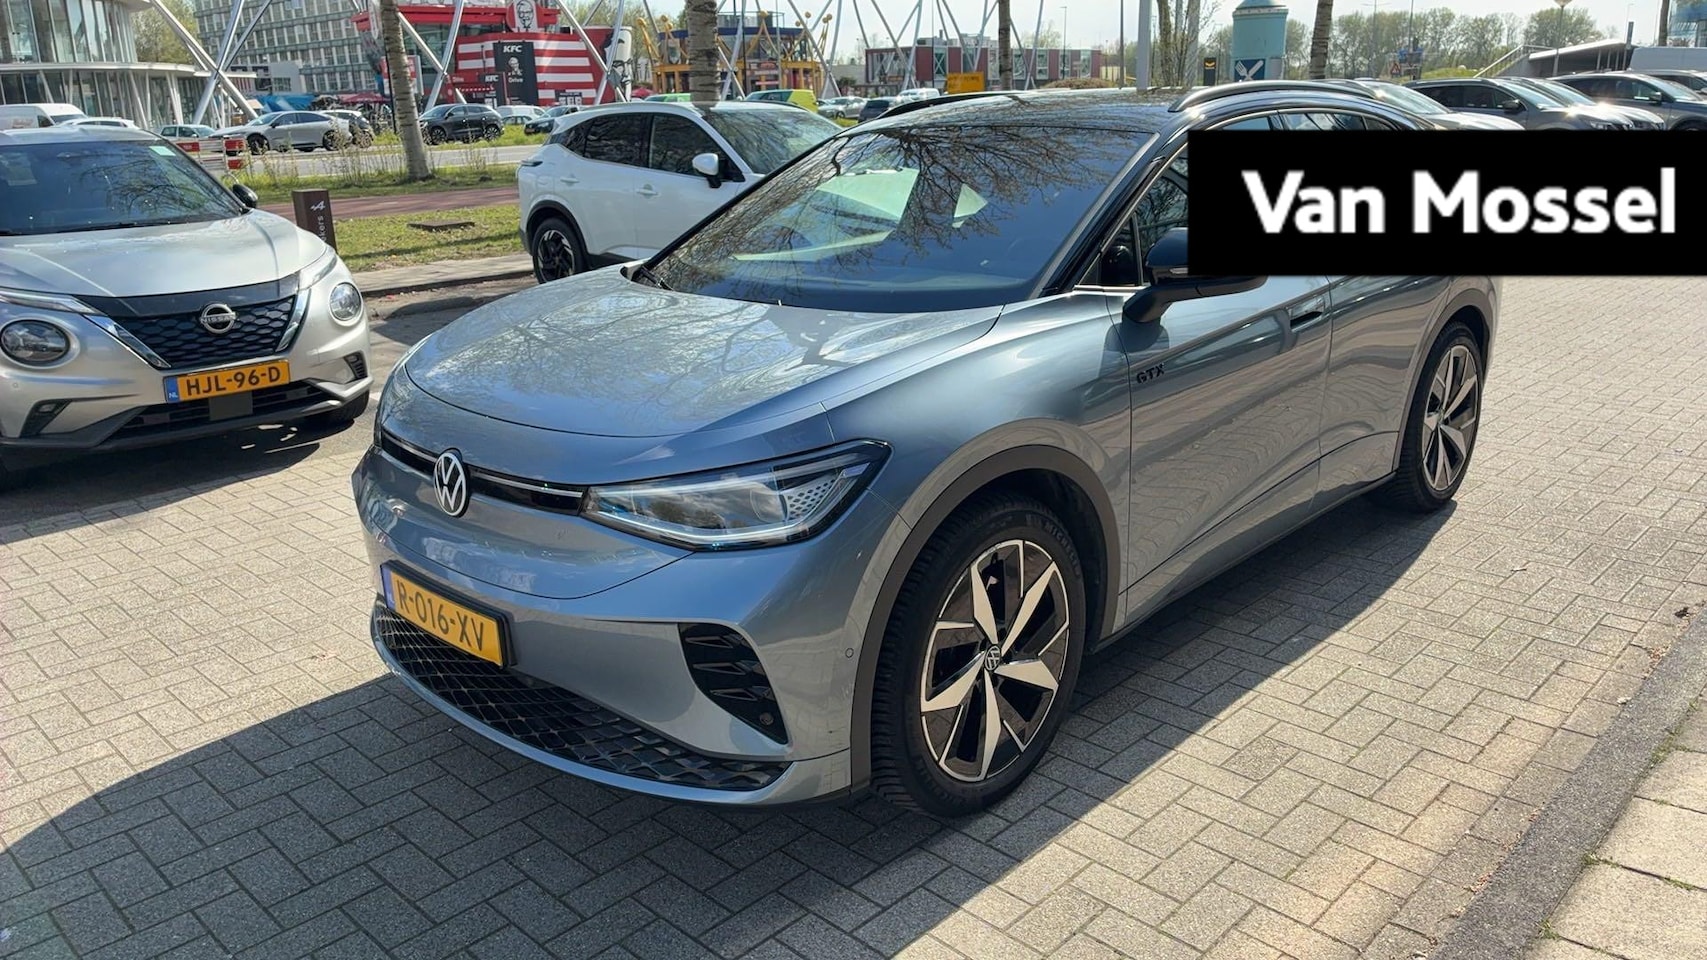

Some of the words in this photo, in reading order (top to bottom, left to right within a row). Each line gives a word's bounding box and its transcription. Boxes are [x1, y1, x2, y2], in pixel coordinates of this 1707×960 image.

[503, 45, 523, 53] KFC
[201, 316, 236, 324] NISSAN
[186, 366, 281, 396] HJL-96-D
[1137, 363, 1164, 383] GTX
[396, 580, 484, 652] R-016-XV
